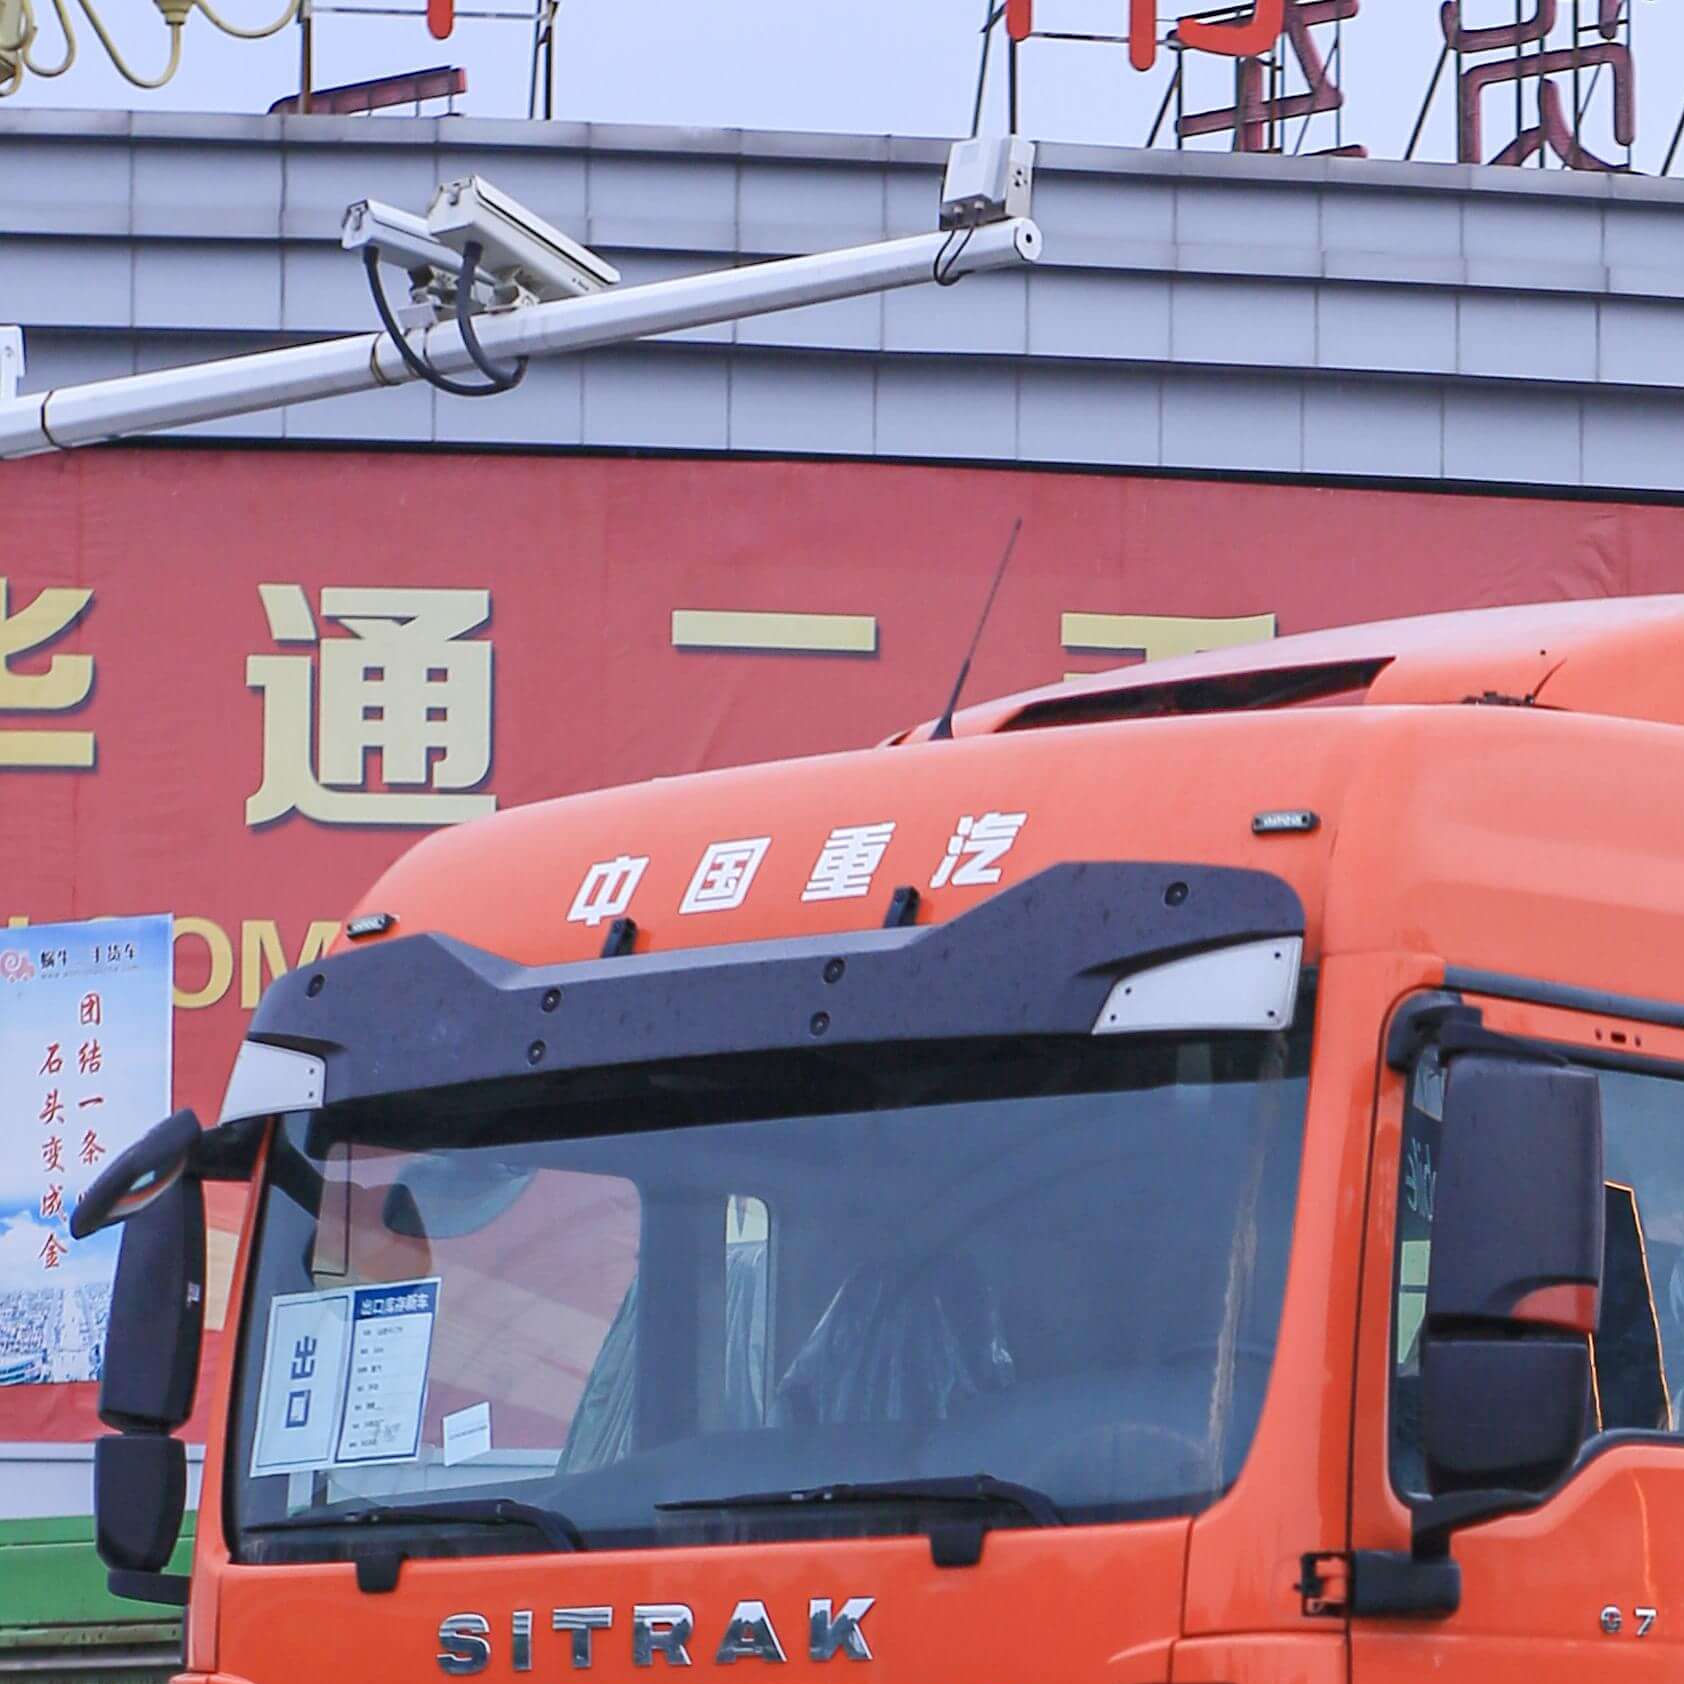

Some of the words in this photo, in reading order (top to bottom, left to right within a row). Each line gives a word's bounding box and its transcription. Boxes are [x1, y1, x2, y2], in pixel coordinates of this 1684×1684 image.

[566, 812, 1027, 925] 中国重汽
[78, 992, 106, 1204] 团结一条
[38, 1042, 68, 1270] 石头变成金
[286, 1335, 318, 1429] 出口
[437, 1597, 876, 1677] SITRAK
